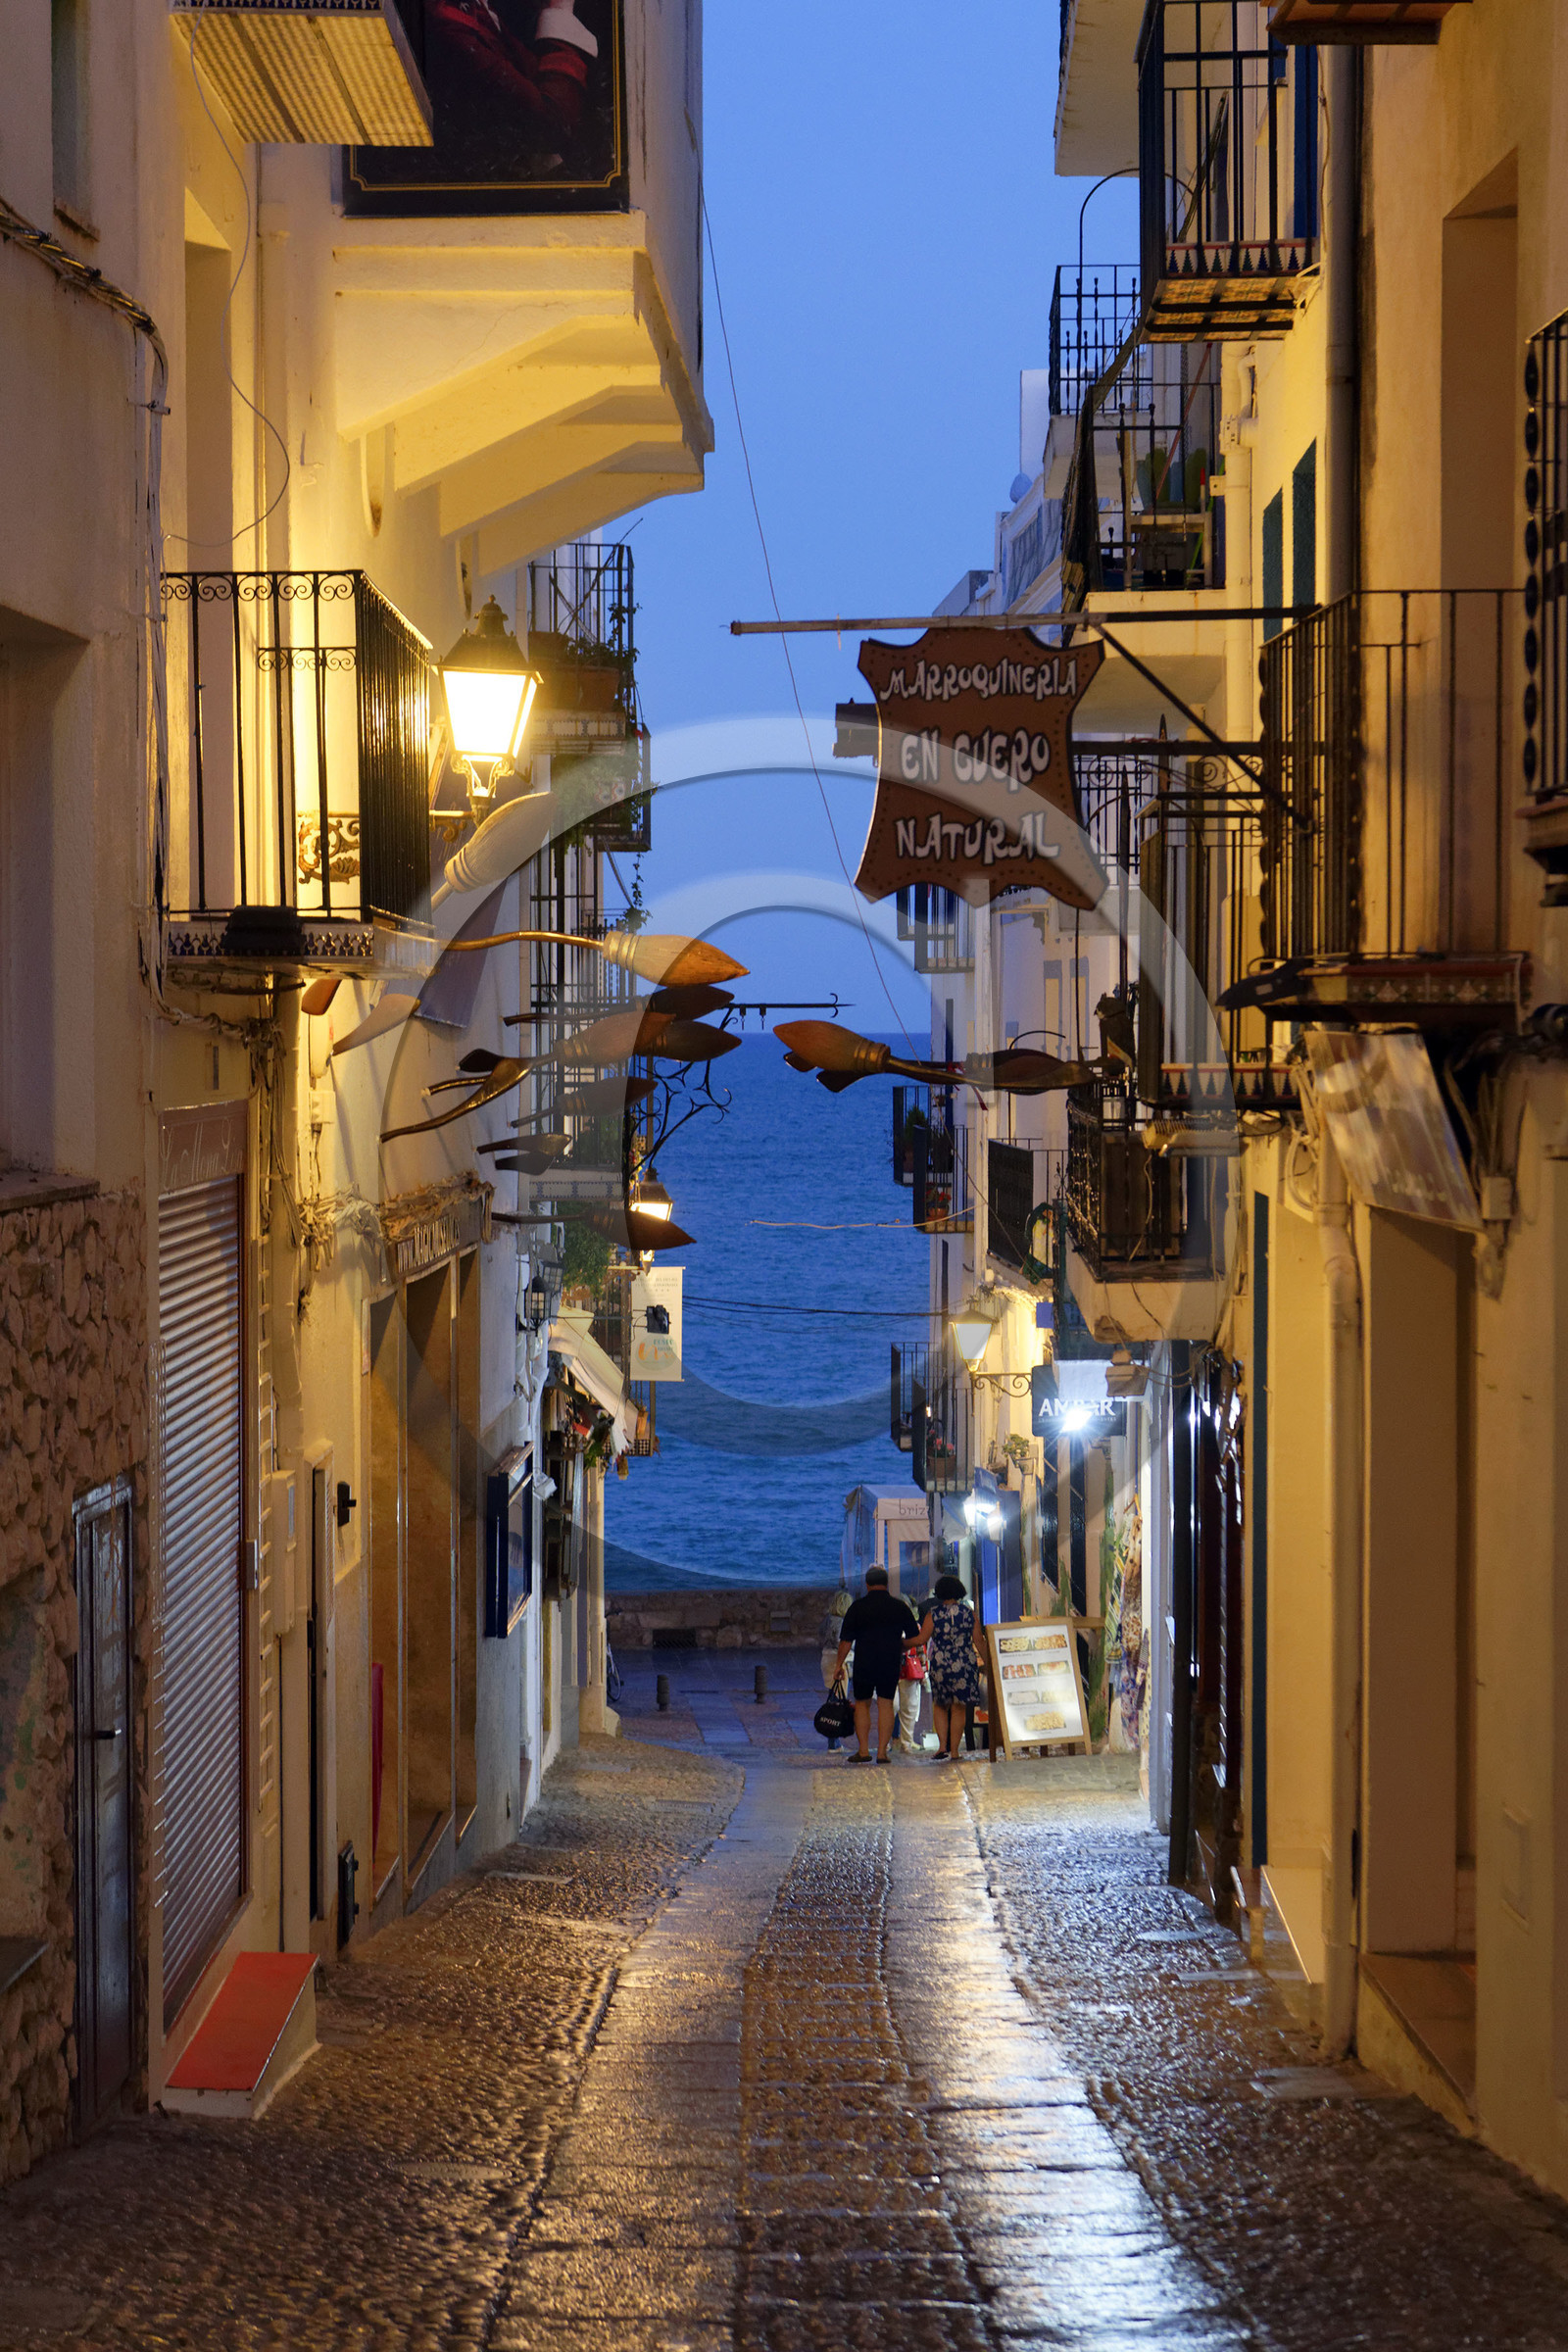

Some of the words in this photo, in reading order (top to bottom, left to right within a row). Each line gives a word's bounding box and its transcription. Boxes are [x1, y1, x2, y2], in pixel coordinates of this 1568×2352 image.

[880, 657, 1077, 702] MARROQUINERIA
[901, 728, 939, 782] EN
[953, 728, 1051, 793] CUERO
[895, 811, 1060, 865] NATURAL
[819, 1716, 841, 1727] SPORT
